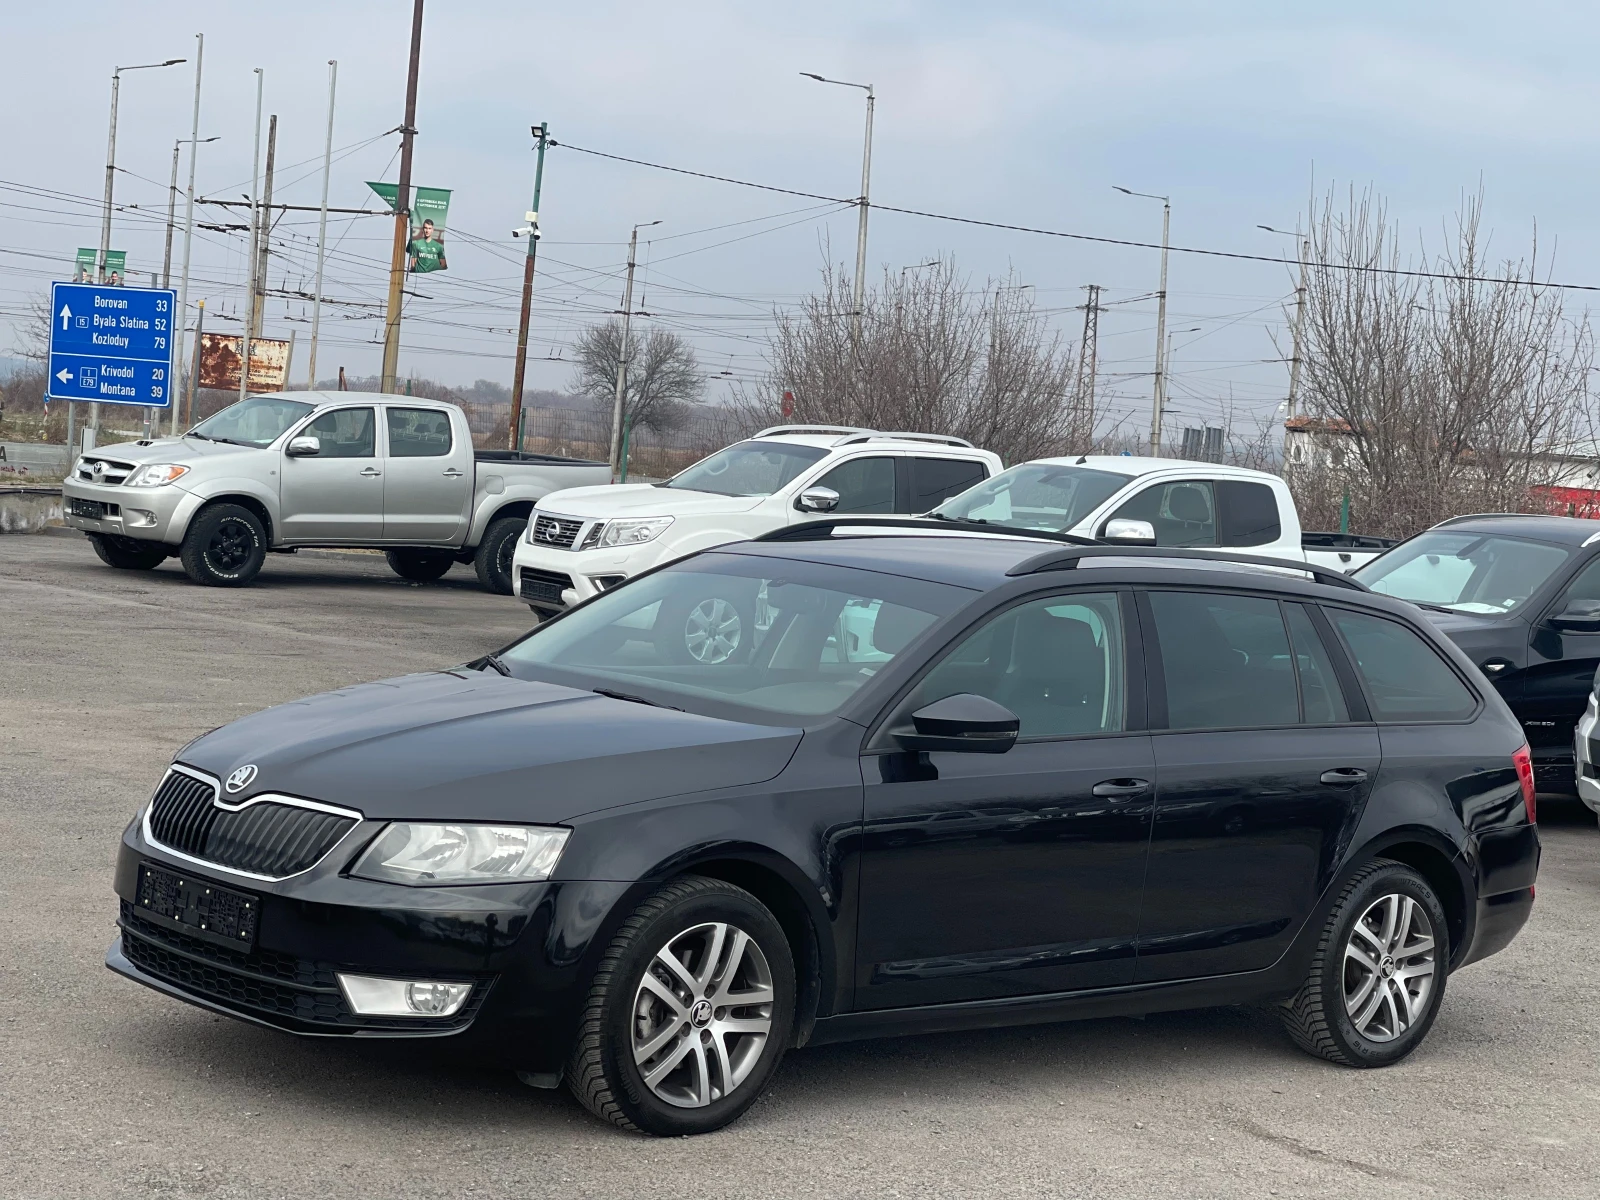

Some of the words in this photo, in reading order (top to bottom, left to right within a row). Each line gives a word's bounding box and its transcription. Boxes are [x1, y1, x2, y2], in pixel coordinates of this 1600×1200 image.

[94, 295, 128, 309] Borovan
[155, 300, 168, 312] 33
[79, 318, 86, 326] 15
[93, 314, 116, 329] Byala
[119, 315, 149, 329] Slatina
[154, 318, 167, 331] 52
[92, 332, 129, 349] Kozloduy
[153, 337, 166, 349] 79
[101, 364, 134, 378] Krivodol
[151, 368, 164, 381] 20
[83, 378, 94, 386] E79
[100, 382, 136, 396] Montana
[150, 386, 163, 398] 39
[220, 516, 255, 534] All-Terrain
